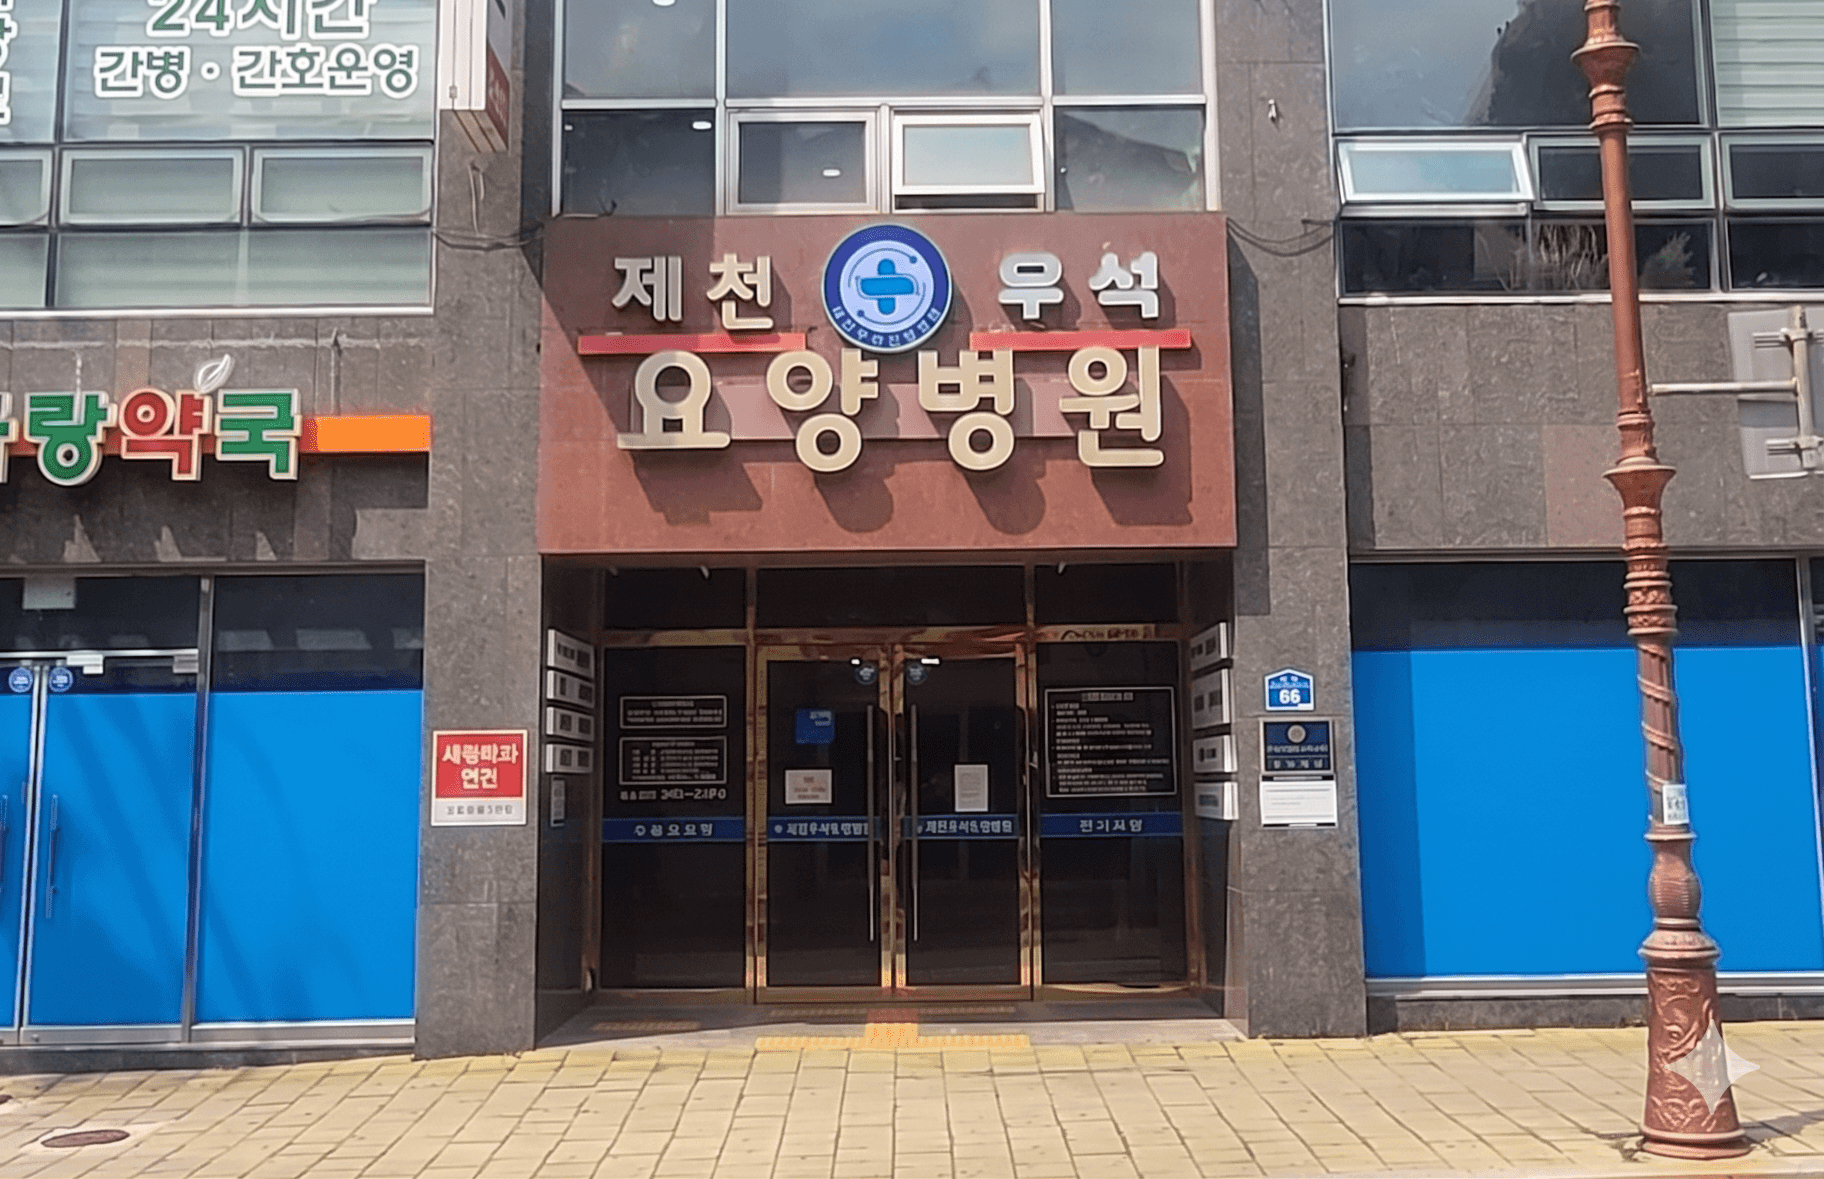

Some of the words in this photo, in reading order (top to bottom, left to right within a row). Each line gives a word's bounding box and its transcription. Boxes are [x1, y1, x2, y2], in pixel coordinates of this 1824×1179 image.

[611, 253, 775, 331] 제천
[998, 250, 1160, 320] 우석
[616, 346, 1165, 473] 요양병원
[1279, 688, 1301, 704] 66
